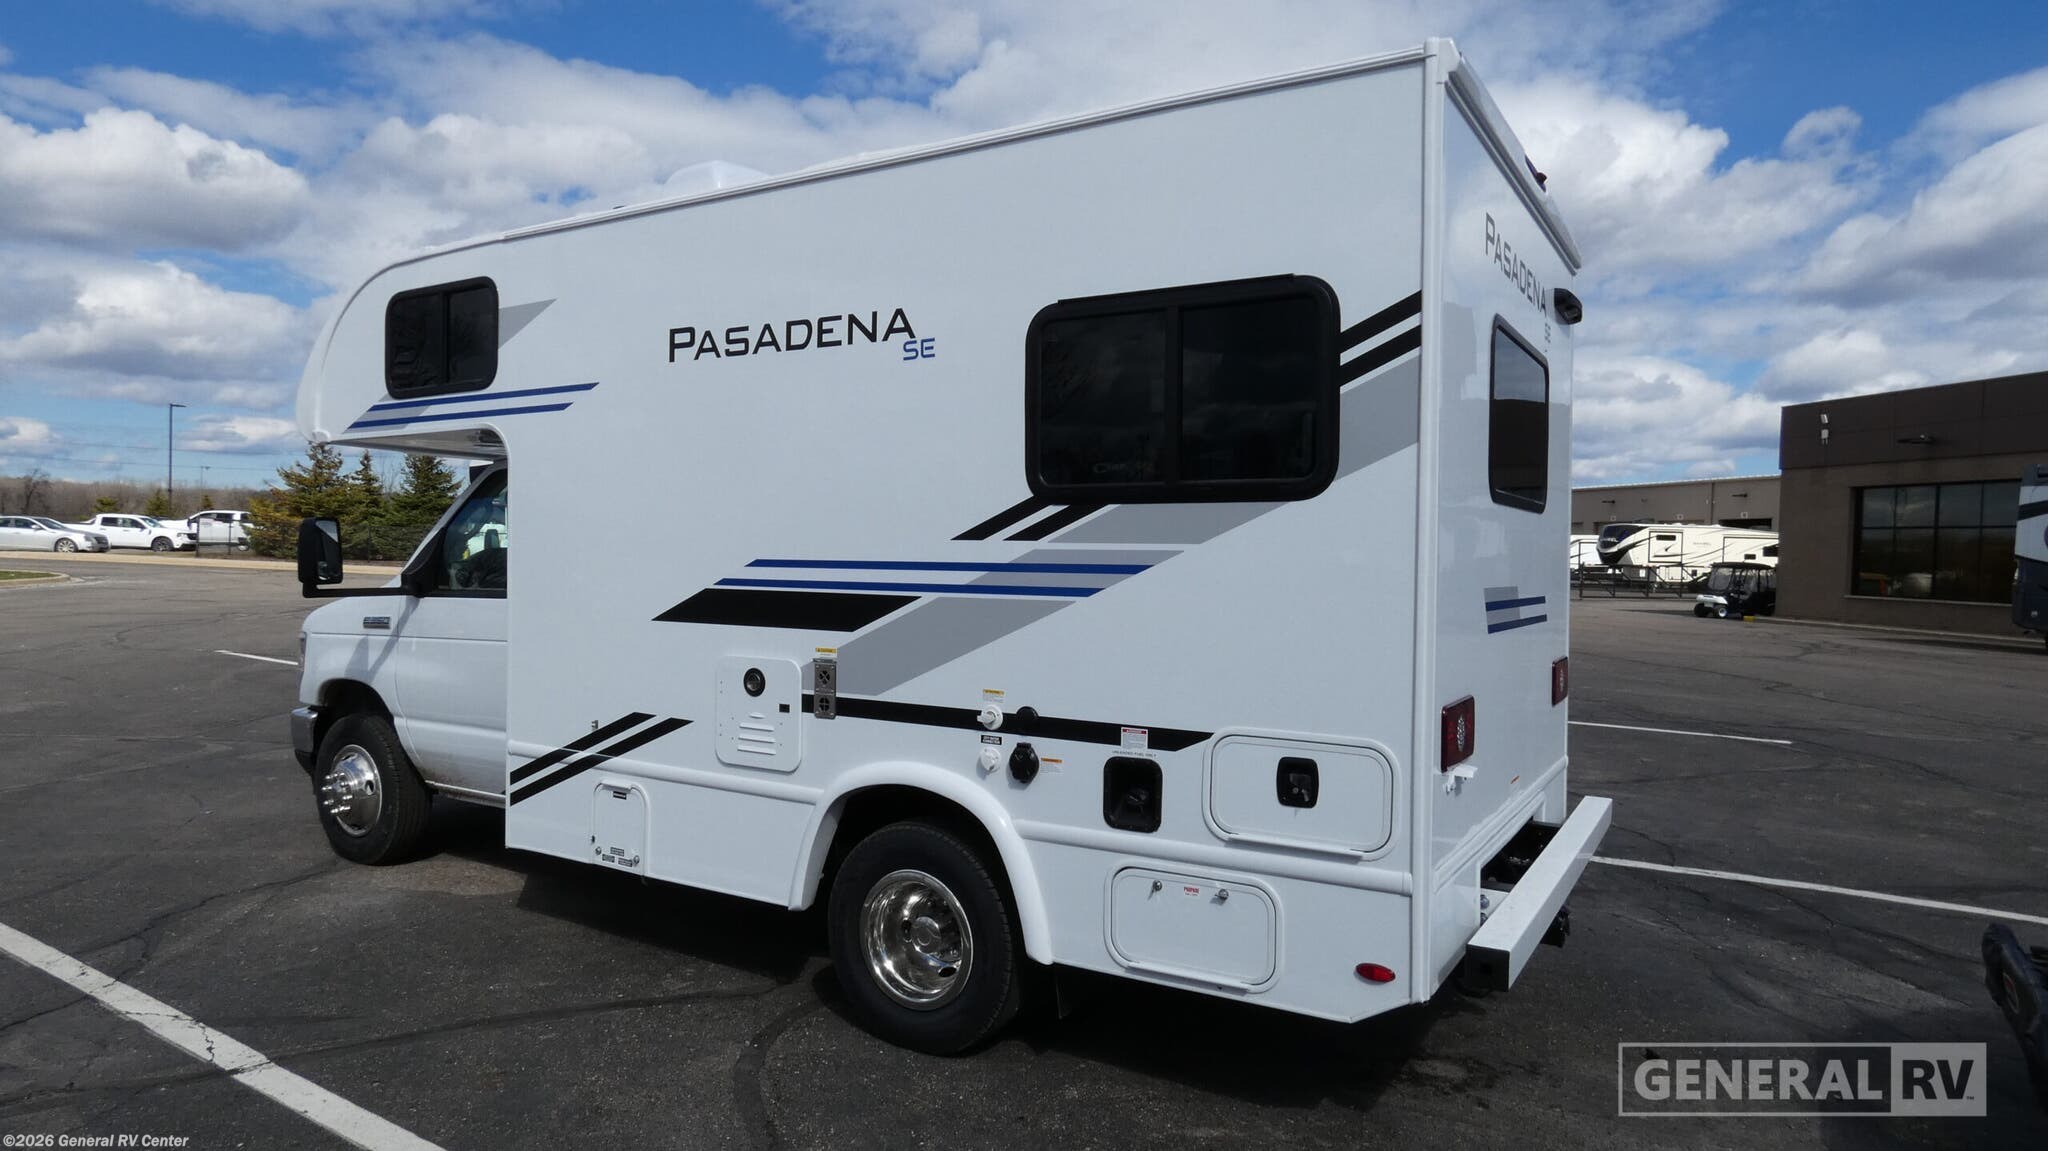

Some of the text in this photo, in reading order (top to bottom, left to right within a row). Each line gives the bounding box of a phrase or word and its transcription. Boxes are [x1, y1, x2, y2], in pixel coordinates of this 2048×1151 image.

[1485, 212, 1547, 318] PASADENA
[668, 307, 916, 363] PASADENA
[903, 337, 936, 361] SE
